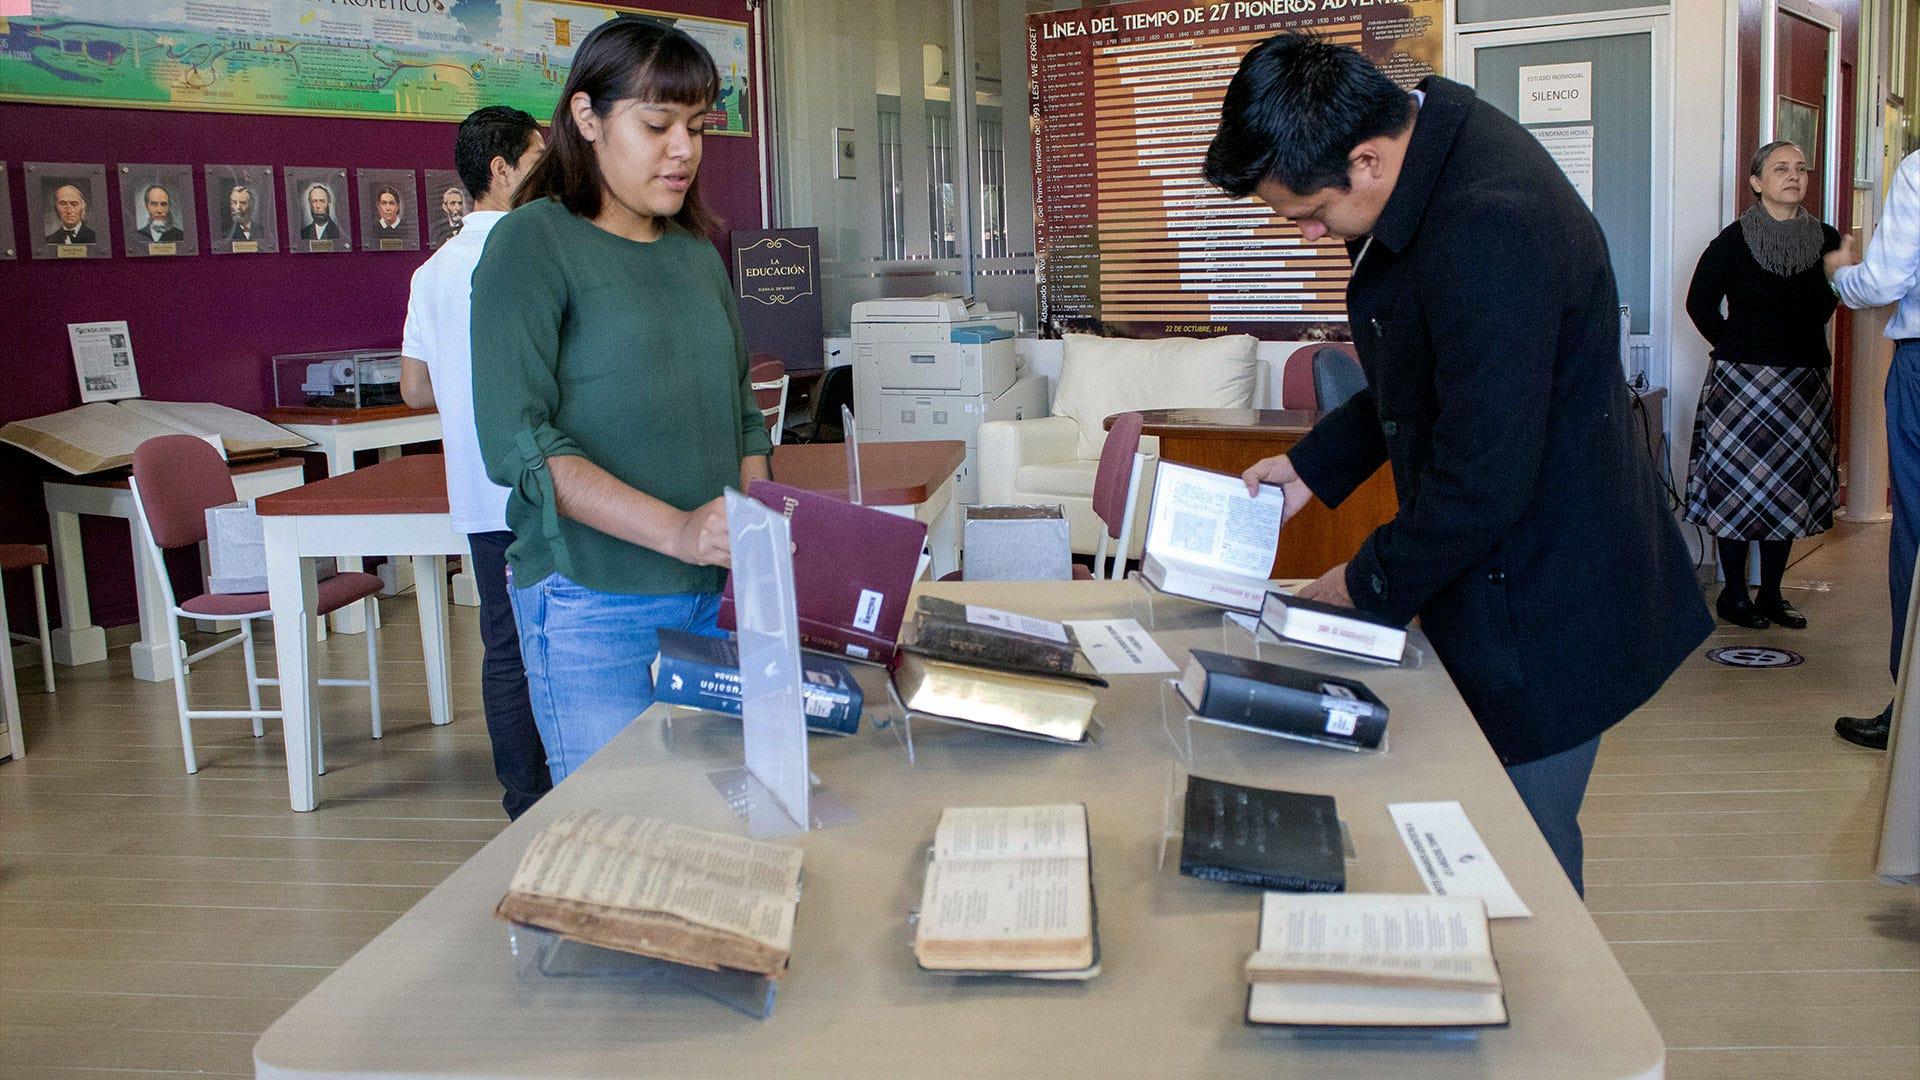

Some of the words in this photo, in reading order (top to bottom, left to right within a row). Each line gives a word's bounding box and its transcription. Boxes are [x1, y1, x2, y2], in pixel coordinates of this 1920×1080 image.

[1043, 21, 1088, 40] LÍNEA
[1091, 16, 1120, 34] DEL
[1122, 10, 1180, 31] TIEMPO
[1183, 7, 1205, 24] DE
[1209, 3, 1229, 22] 27
[1234, 0, 1316, 20] PIONEROS
[1030, 27, 1038, 61] FORGET
[1031, 63, 1038, 77] WE
[1532, 89, 1579, 102] SILENCIO
[746, 264, 805, 277] EDUCACIÓN
